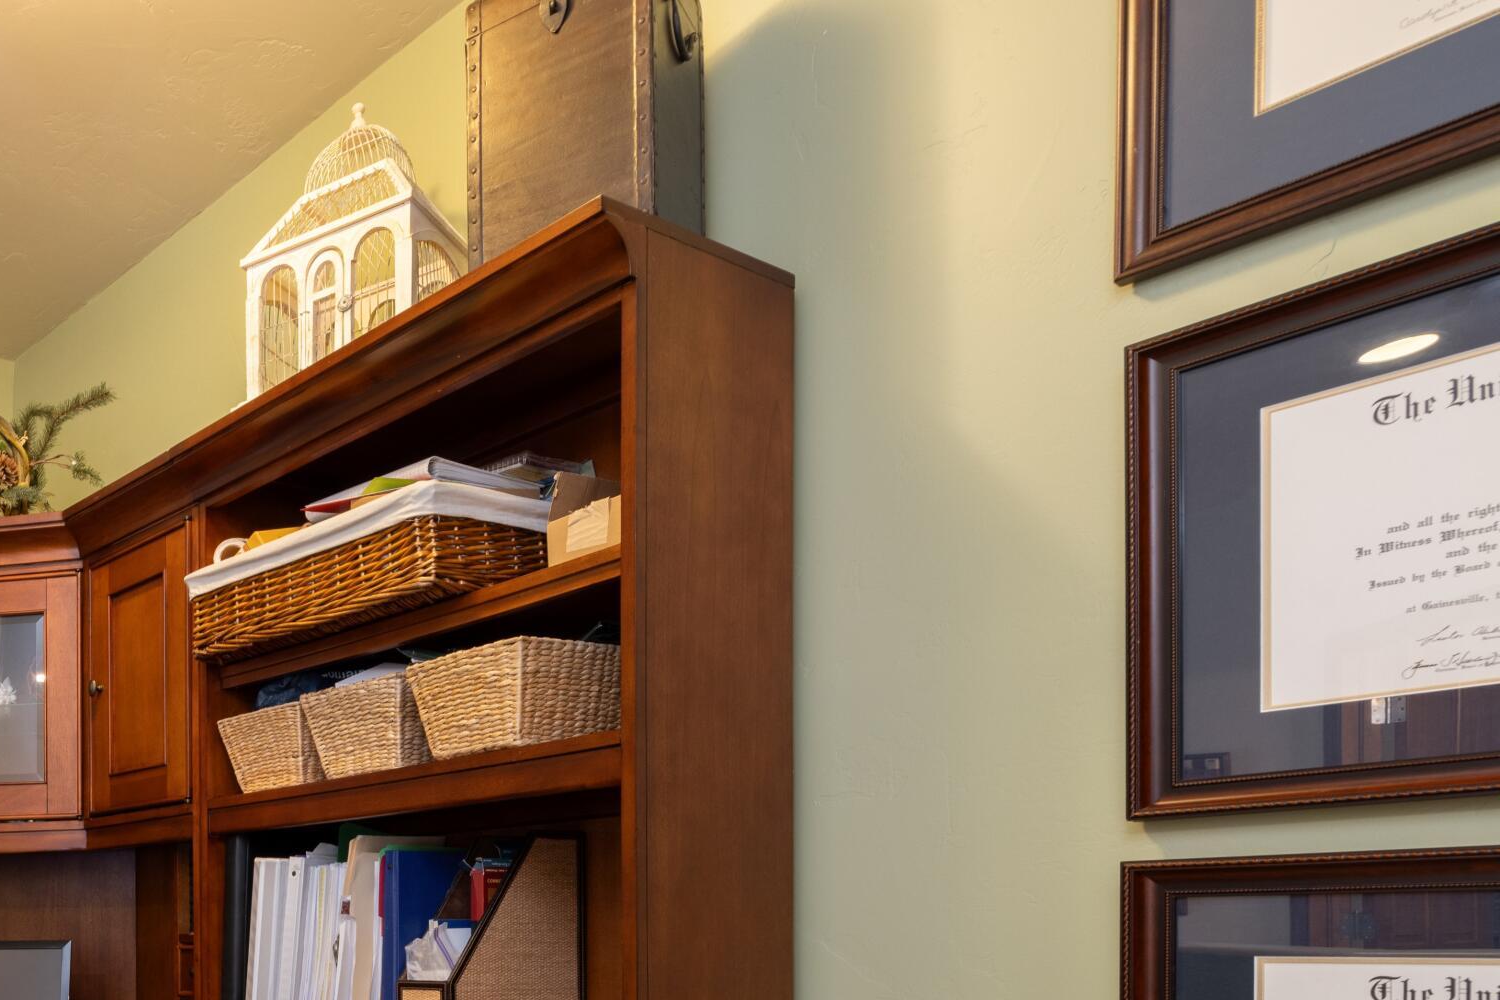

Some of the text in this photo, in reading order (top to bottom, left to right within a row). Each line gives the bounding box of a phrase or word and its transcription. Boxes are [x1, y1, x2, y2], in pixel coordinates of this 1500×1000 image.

[1372, 374, 1500, 425] The Un
[1387, 521, 1410, 534] and
[1417, 515, 1434, 528] all
[1441, 512, 1461, 524] the
[1355, 547, 1372, 560] In
[1379, 537, 1432, 555] Witness
[1445, 541, 1498, 558] and the
[1368, 576, 1406, 591] Issued
[1412, 573, 1425, 583] by
[1431, 568, 1448, 579] the
[1454, 561, 1490, 577] Board
